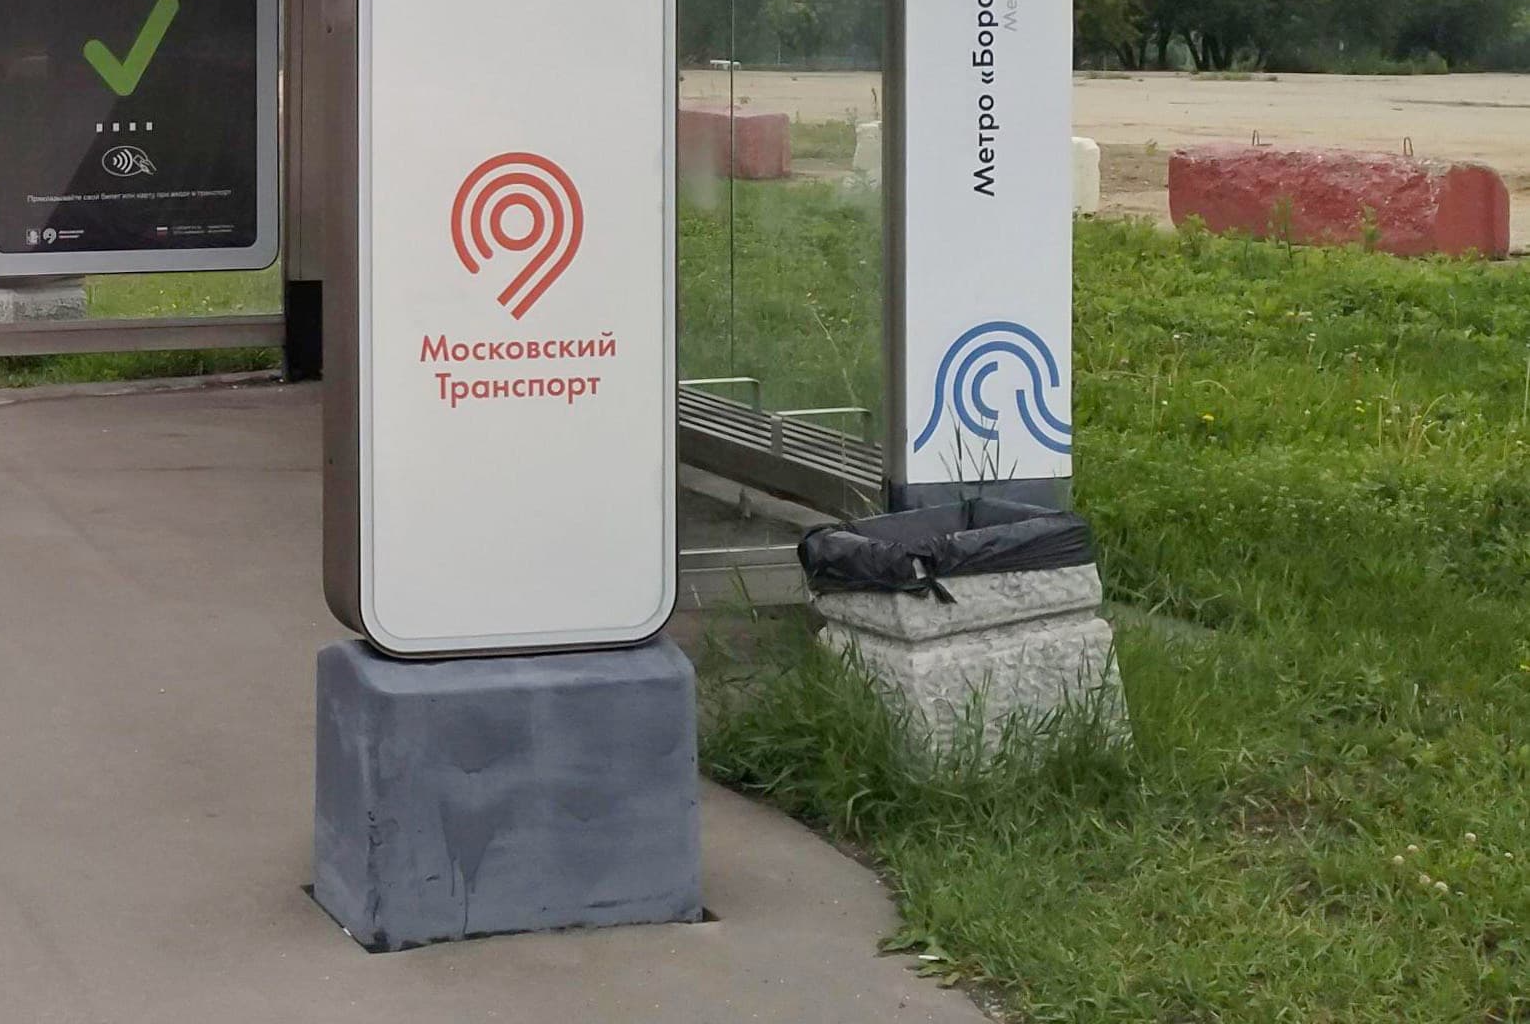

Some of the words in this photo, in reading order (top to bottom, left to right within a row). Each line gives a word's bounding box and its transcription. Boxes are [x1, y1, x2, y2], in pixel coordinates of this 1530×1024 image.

[973, 94, 1000, 197] Метро
[420, 331, 617, 363] Московский
[435, 372, 601, 408] Транспорт
